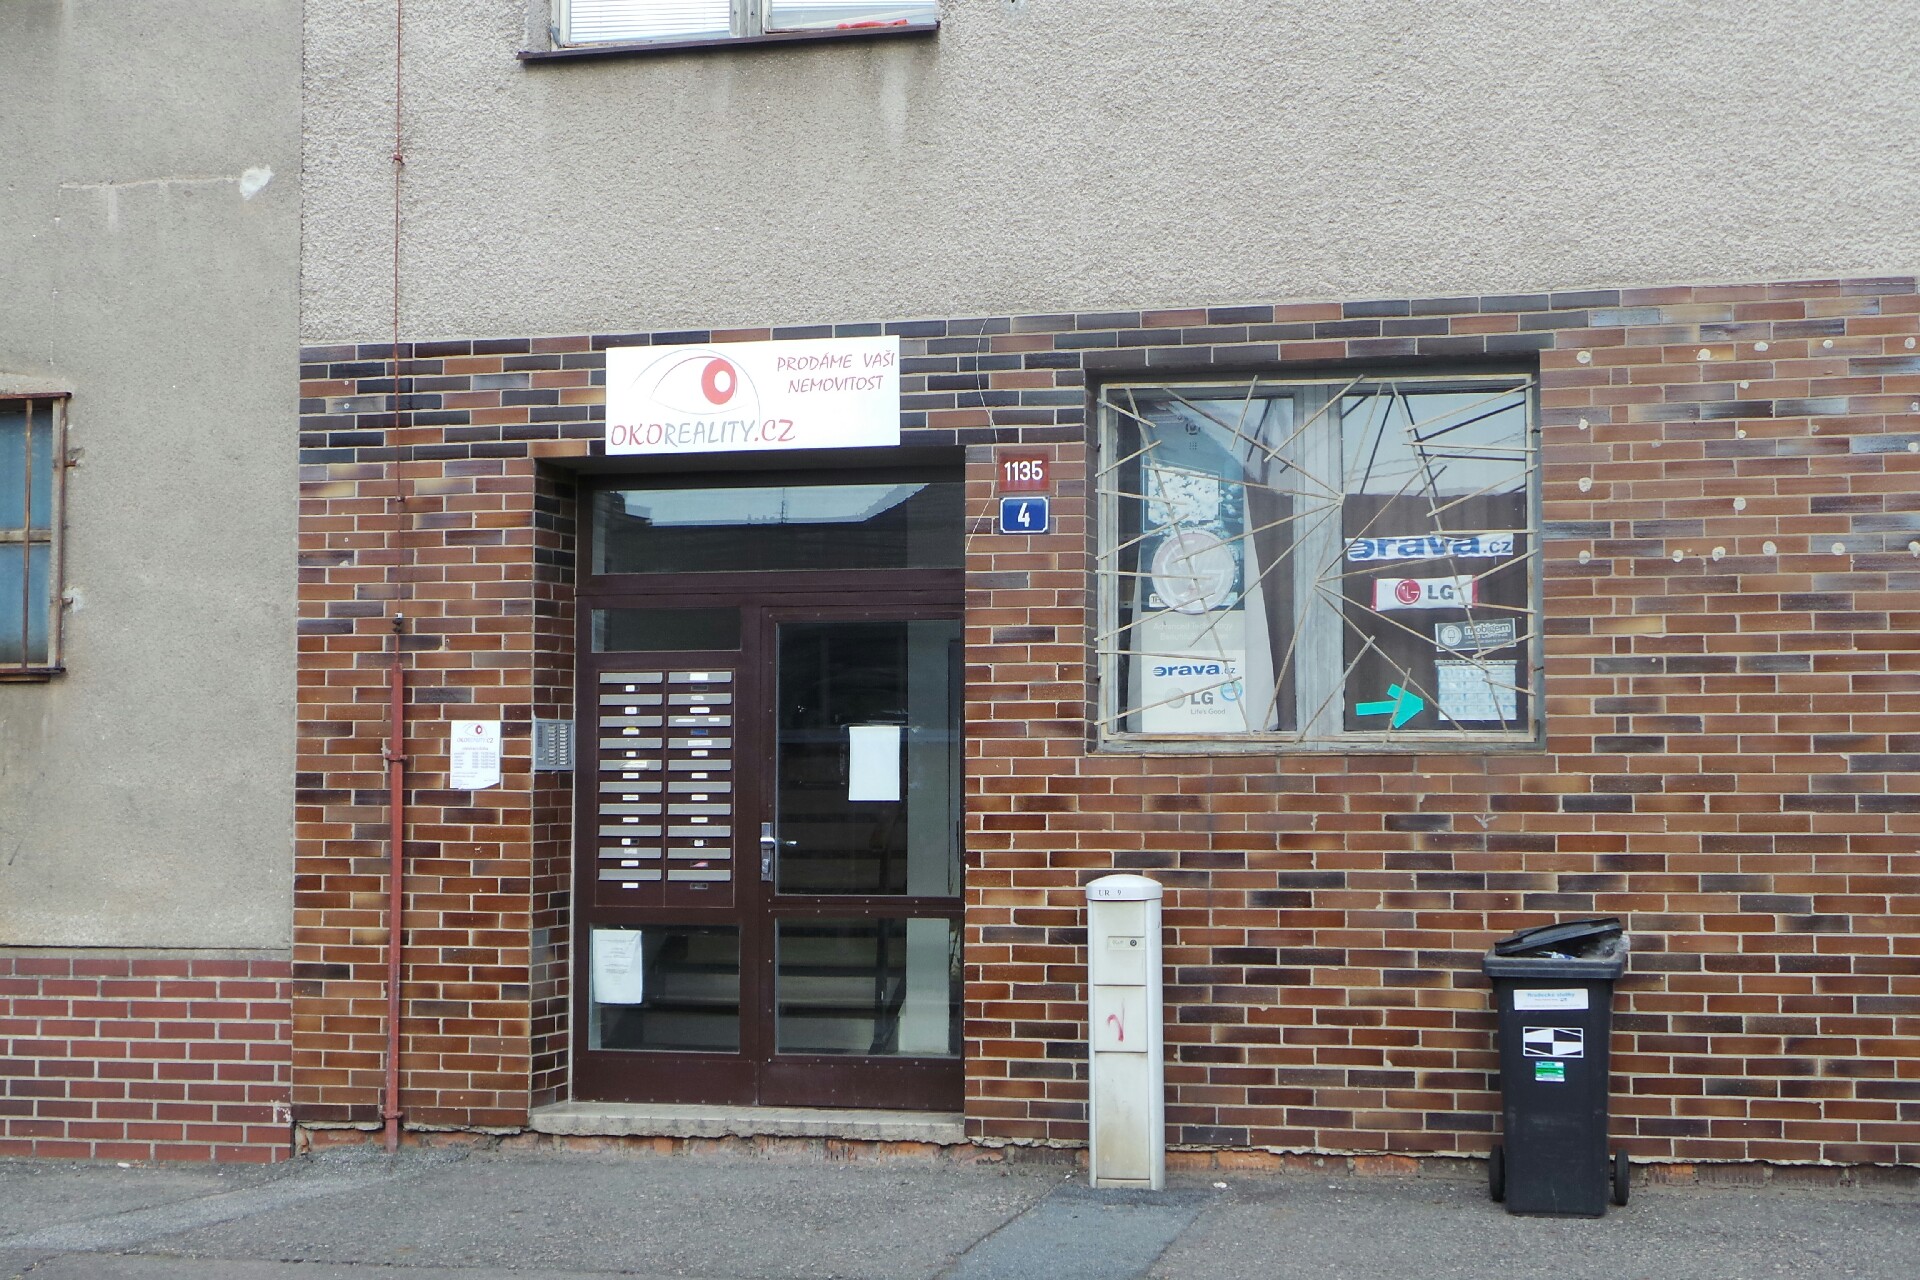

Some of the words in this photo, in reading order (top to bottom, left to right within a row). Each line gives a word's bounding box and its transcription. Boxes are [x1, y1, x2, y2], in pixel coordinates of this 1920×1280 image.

[777, 352, 852, 372] PRODÁME
[863, 349, 895, 368] VAŠI
[788, 375, 884, 394] NEMOVITOST
[610, 419, 796, 448] OKOREALITY.CZ
[1004, 460, 1043, 481] 1135
[1017, 502, 1030, 528] 4
[1427, 584, 1454, 600] LG
[1190, 691, 1214, 705] LG
